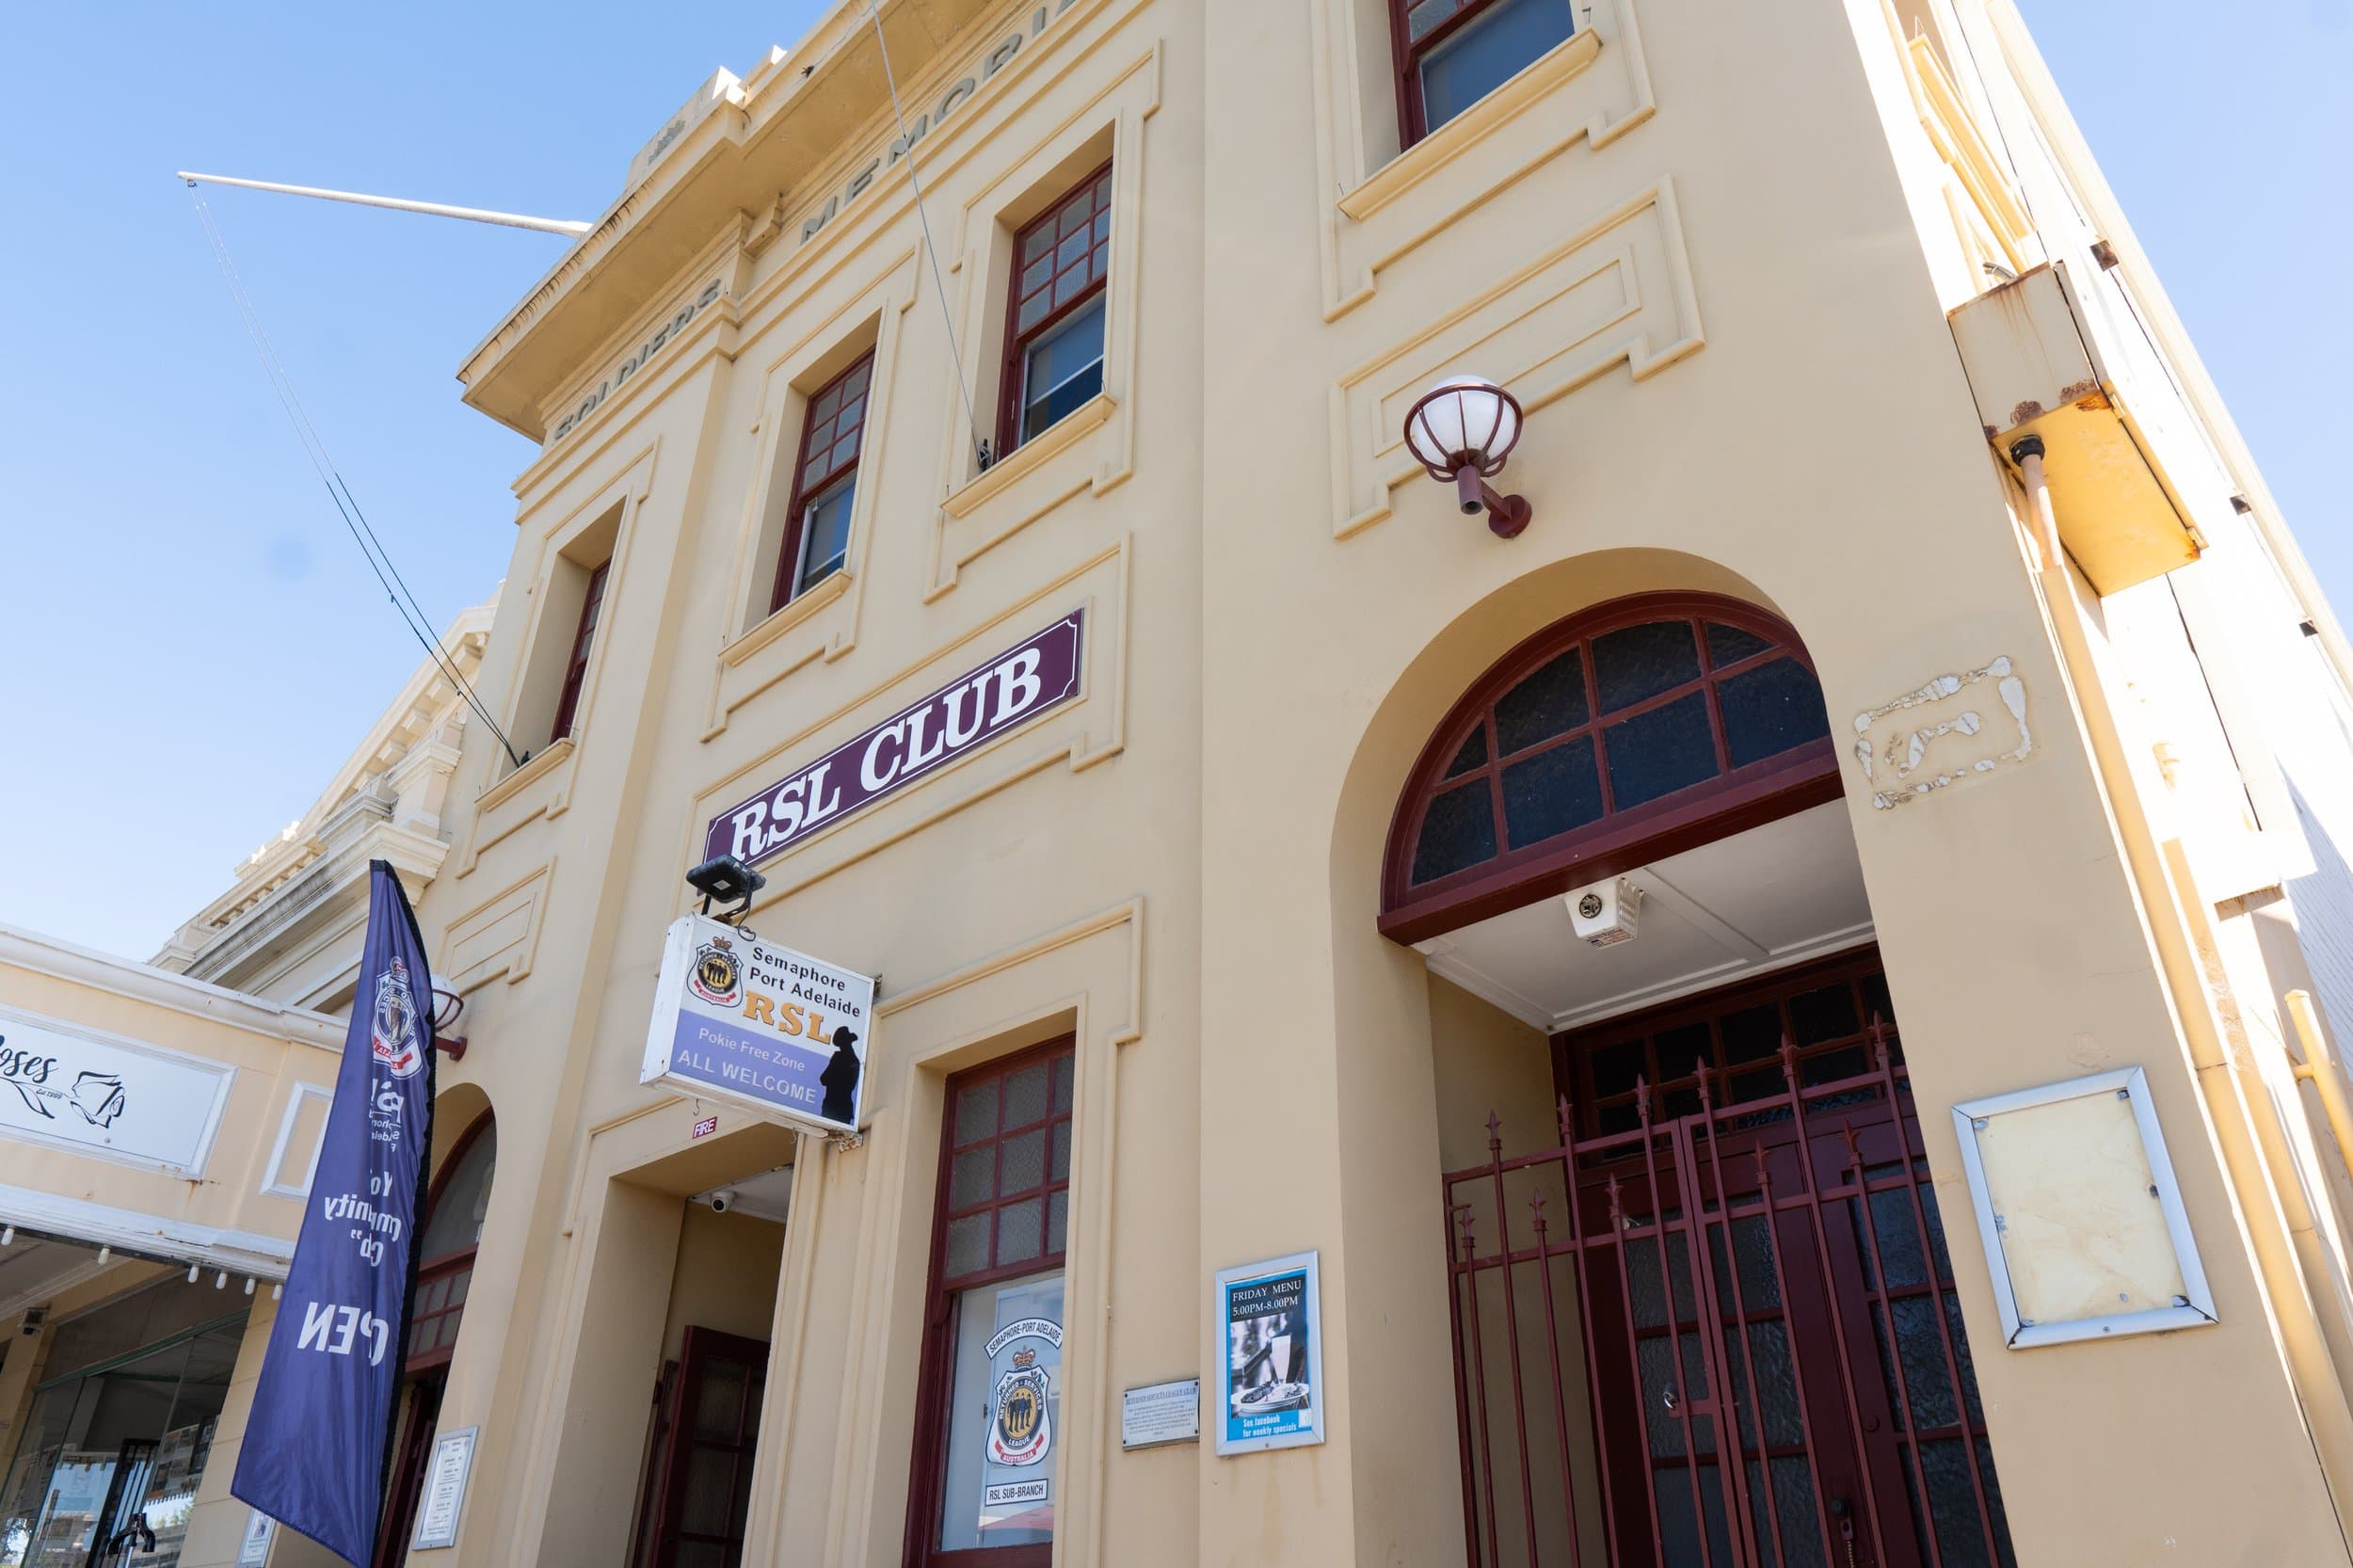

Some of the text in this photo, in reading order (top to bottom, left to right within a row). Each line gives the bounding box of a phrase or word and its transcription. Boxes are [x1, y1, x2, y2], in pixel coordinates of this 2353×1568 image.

[730, 648, 1042, 862] RSL CLUB
[752, 947, 846, 991] Semaphore
[749, 968, 861, 1018] Port Adelaide
[742, 989, 831, 1045] RSL
[0, 1034, 59, 1084] oses
[698, 1027, 806, 1072] Pokie Free Zone
[678, 1049, 817, 1105] ALL WELCOME
[693, 1117, 716, 1139] FIRE
[1232, 1279, 1303, 1303] FRIDAY MENU
[1232, 1295, 1299, 1318] 5.00PM-8.00PM
[988, 1320, 1062, 1353] SEMAPHORE-PORT ADELAIDE
[1242, 1415, 1281, 1428] See facebook
[1242, 1423, 1297, 1438] for weekly specials
[1008, 1434, 1031, 1447] LEAGUE
[1002, 1449, 1034, 1463] AUSTRALIA
[989, 1483, 1044, 1501] RSL SUB-BRANCH
